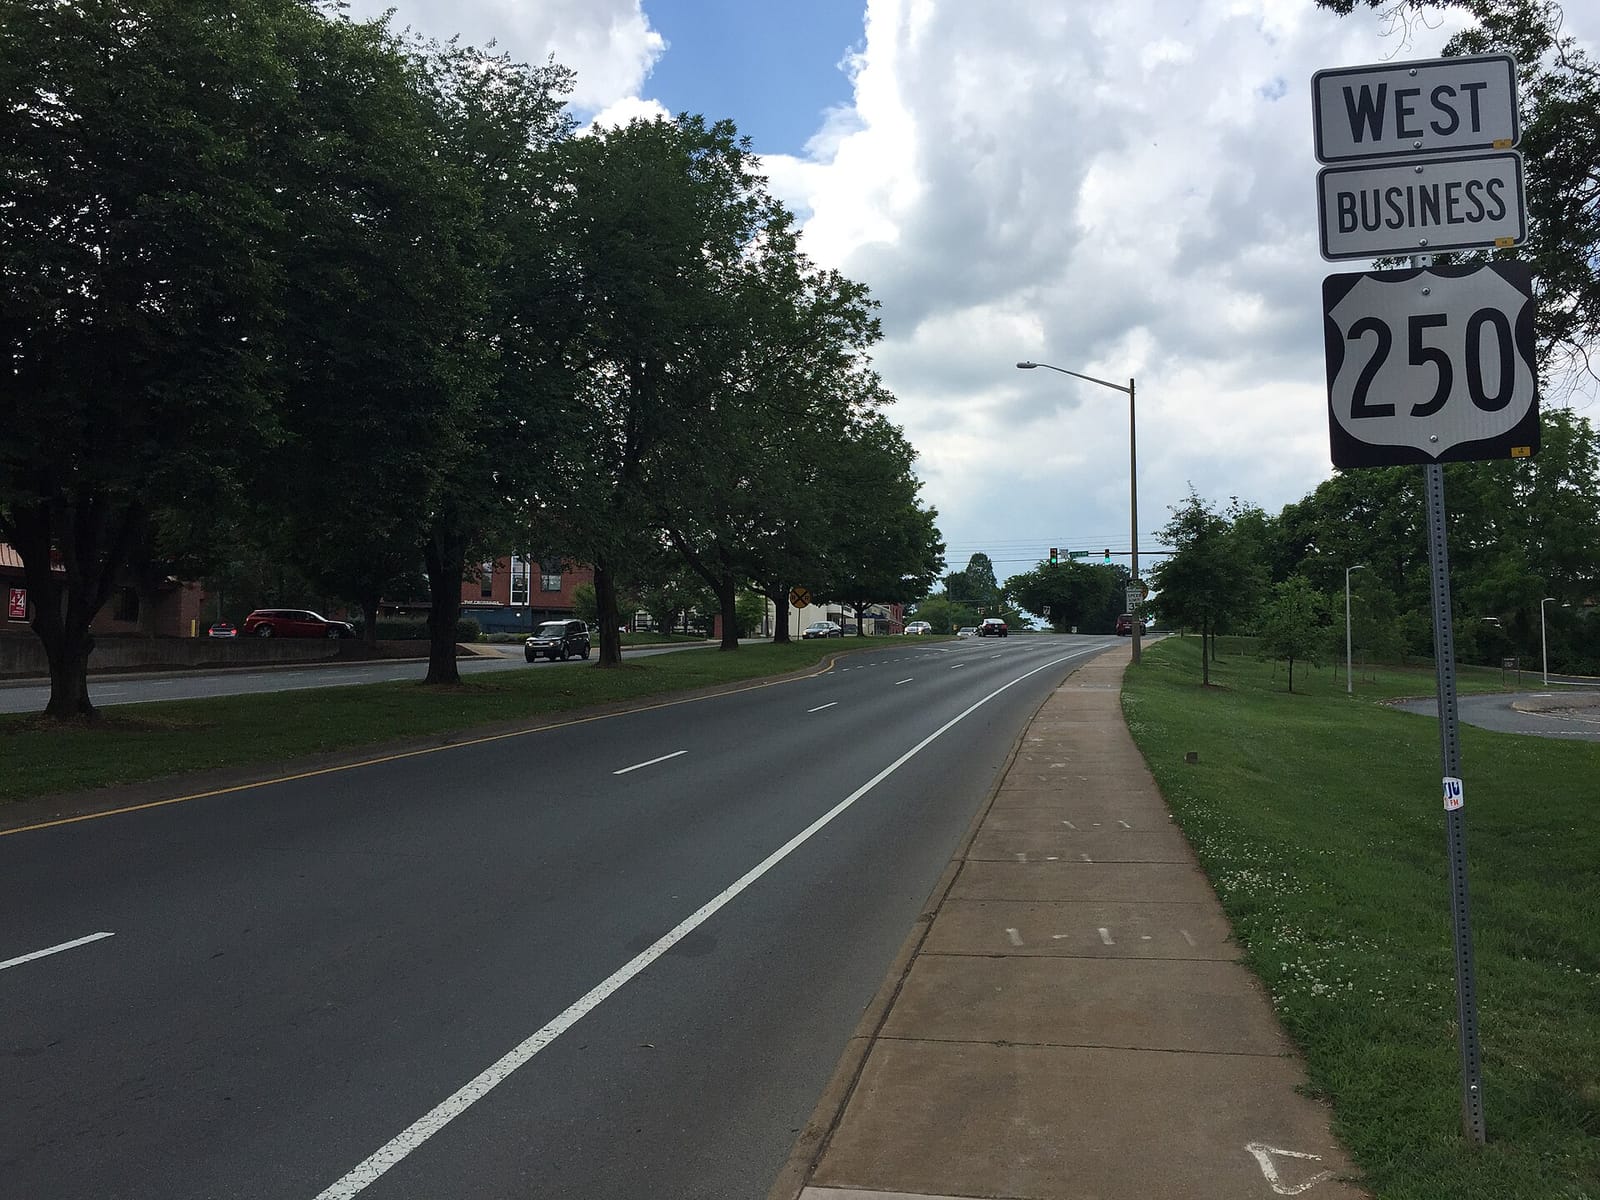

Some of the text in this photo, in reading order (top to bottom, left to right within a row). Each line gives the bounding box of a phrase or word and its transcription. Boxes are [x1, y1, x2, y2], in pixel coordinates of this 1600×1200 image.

[1342, 82, 1488, 143] WEST
[1337, 178, 1506, 233] BUSINESS
[1347, 307, 1515, 419] 250
